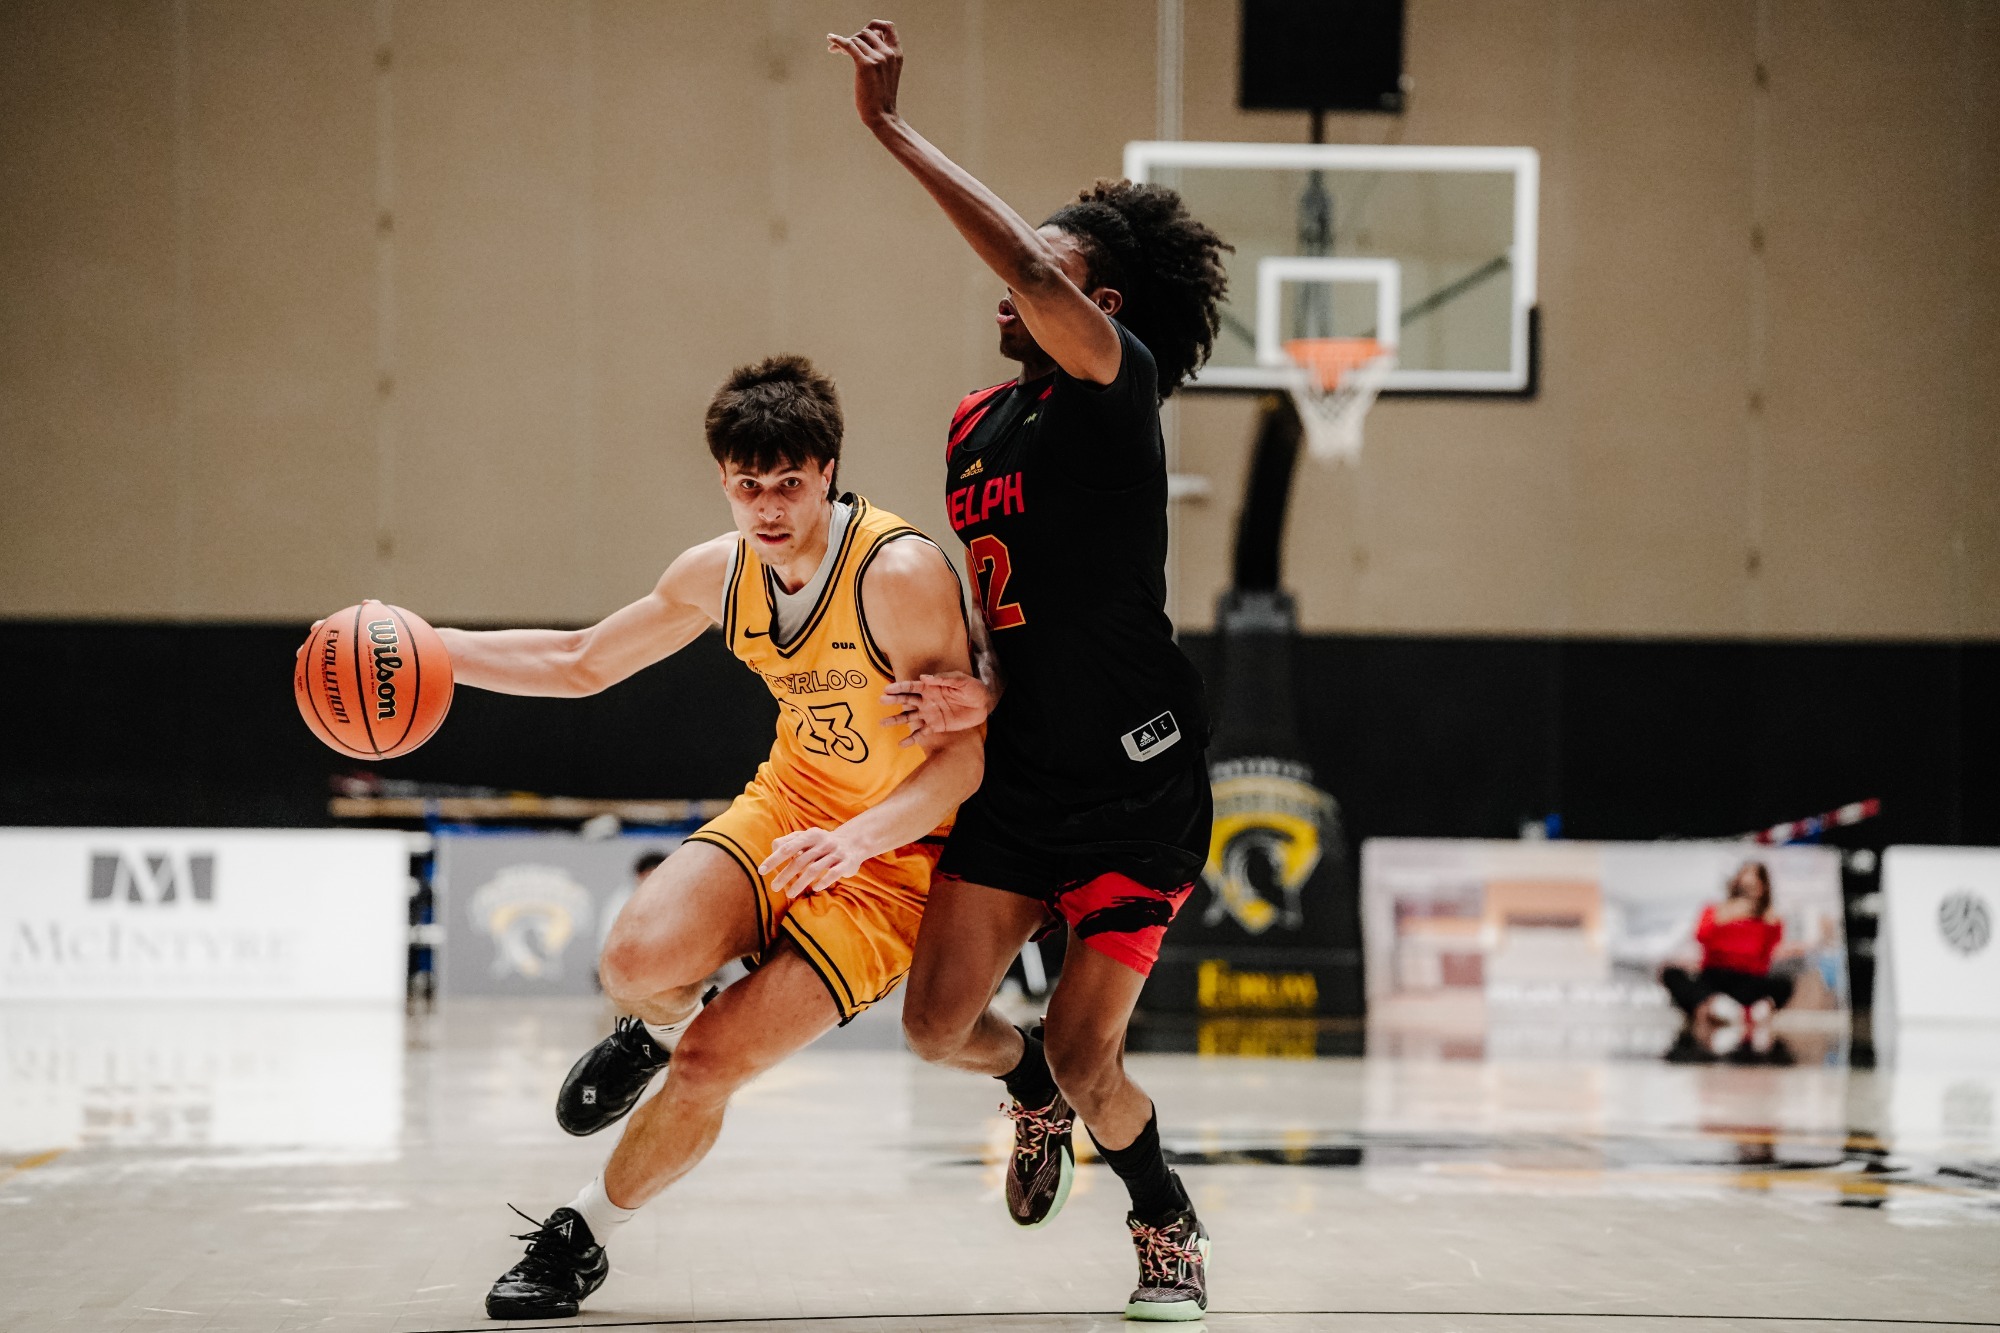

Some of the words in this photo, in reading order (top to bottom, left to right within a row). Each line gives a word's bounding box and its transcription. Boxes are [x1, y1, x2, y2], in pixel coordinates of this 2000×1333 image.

[946, 471, 1025, 531] ELPH
[960, 467, 984, 480] adidas
[968, 533, 1027, 630] 2
[325, 630, 350, 723] EVOLUTION
[367, 618, 402, 720] Wilson
[831, 641, 857, 650] OUA
[778, 698, 869, 763] 23
